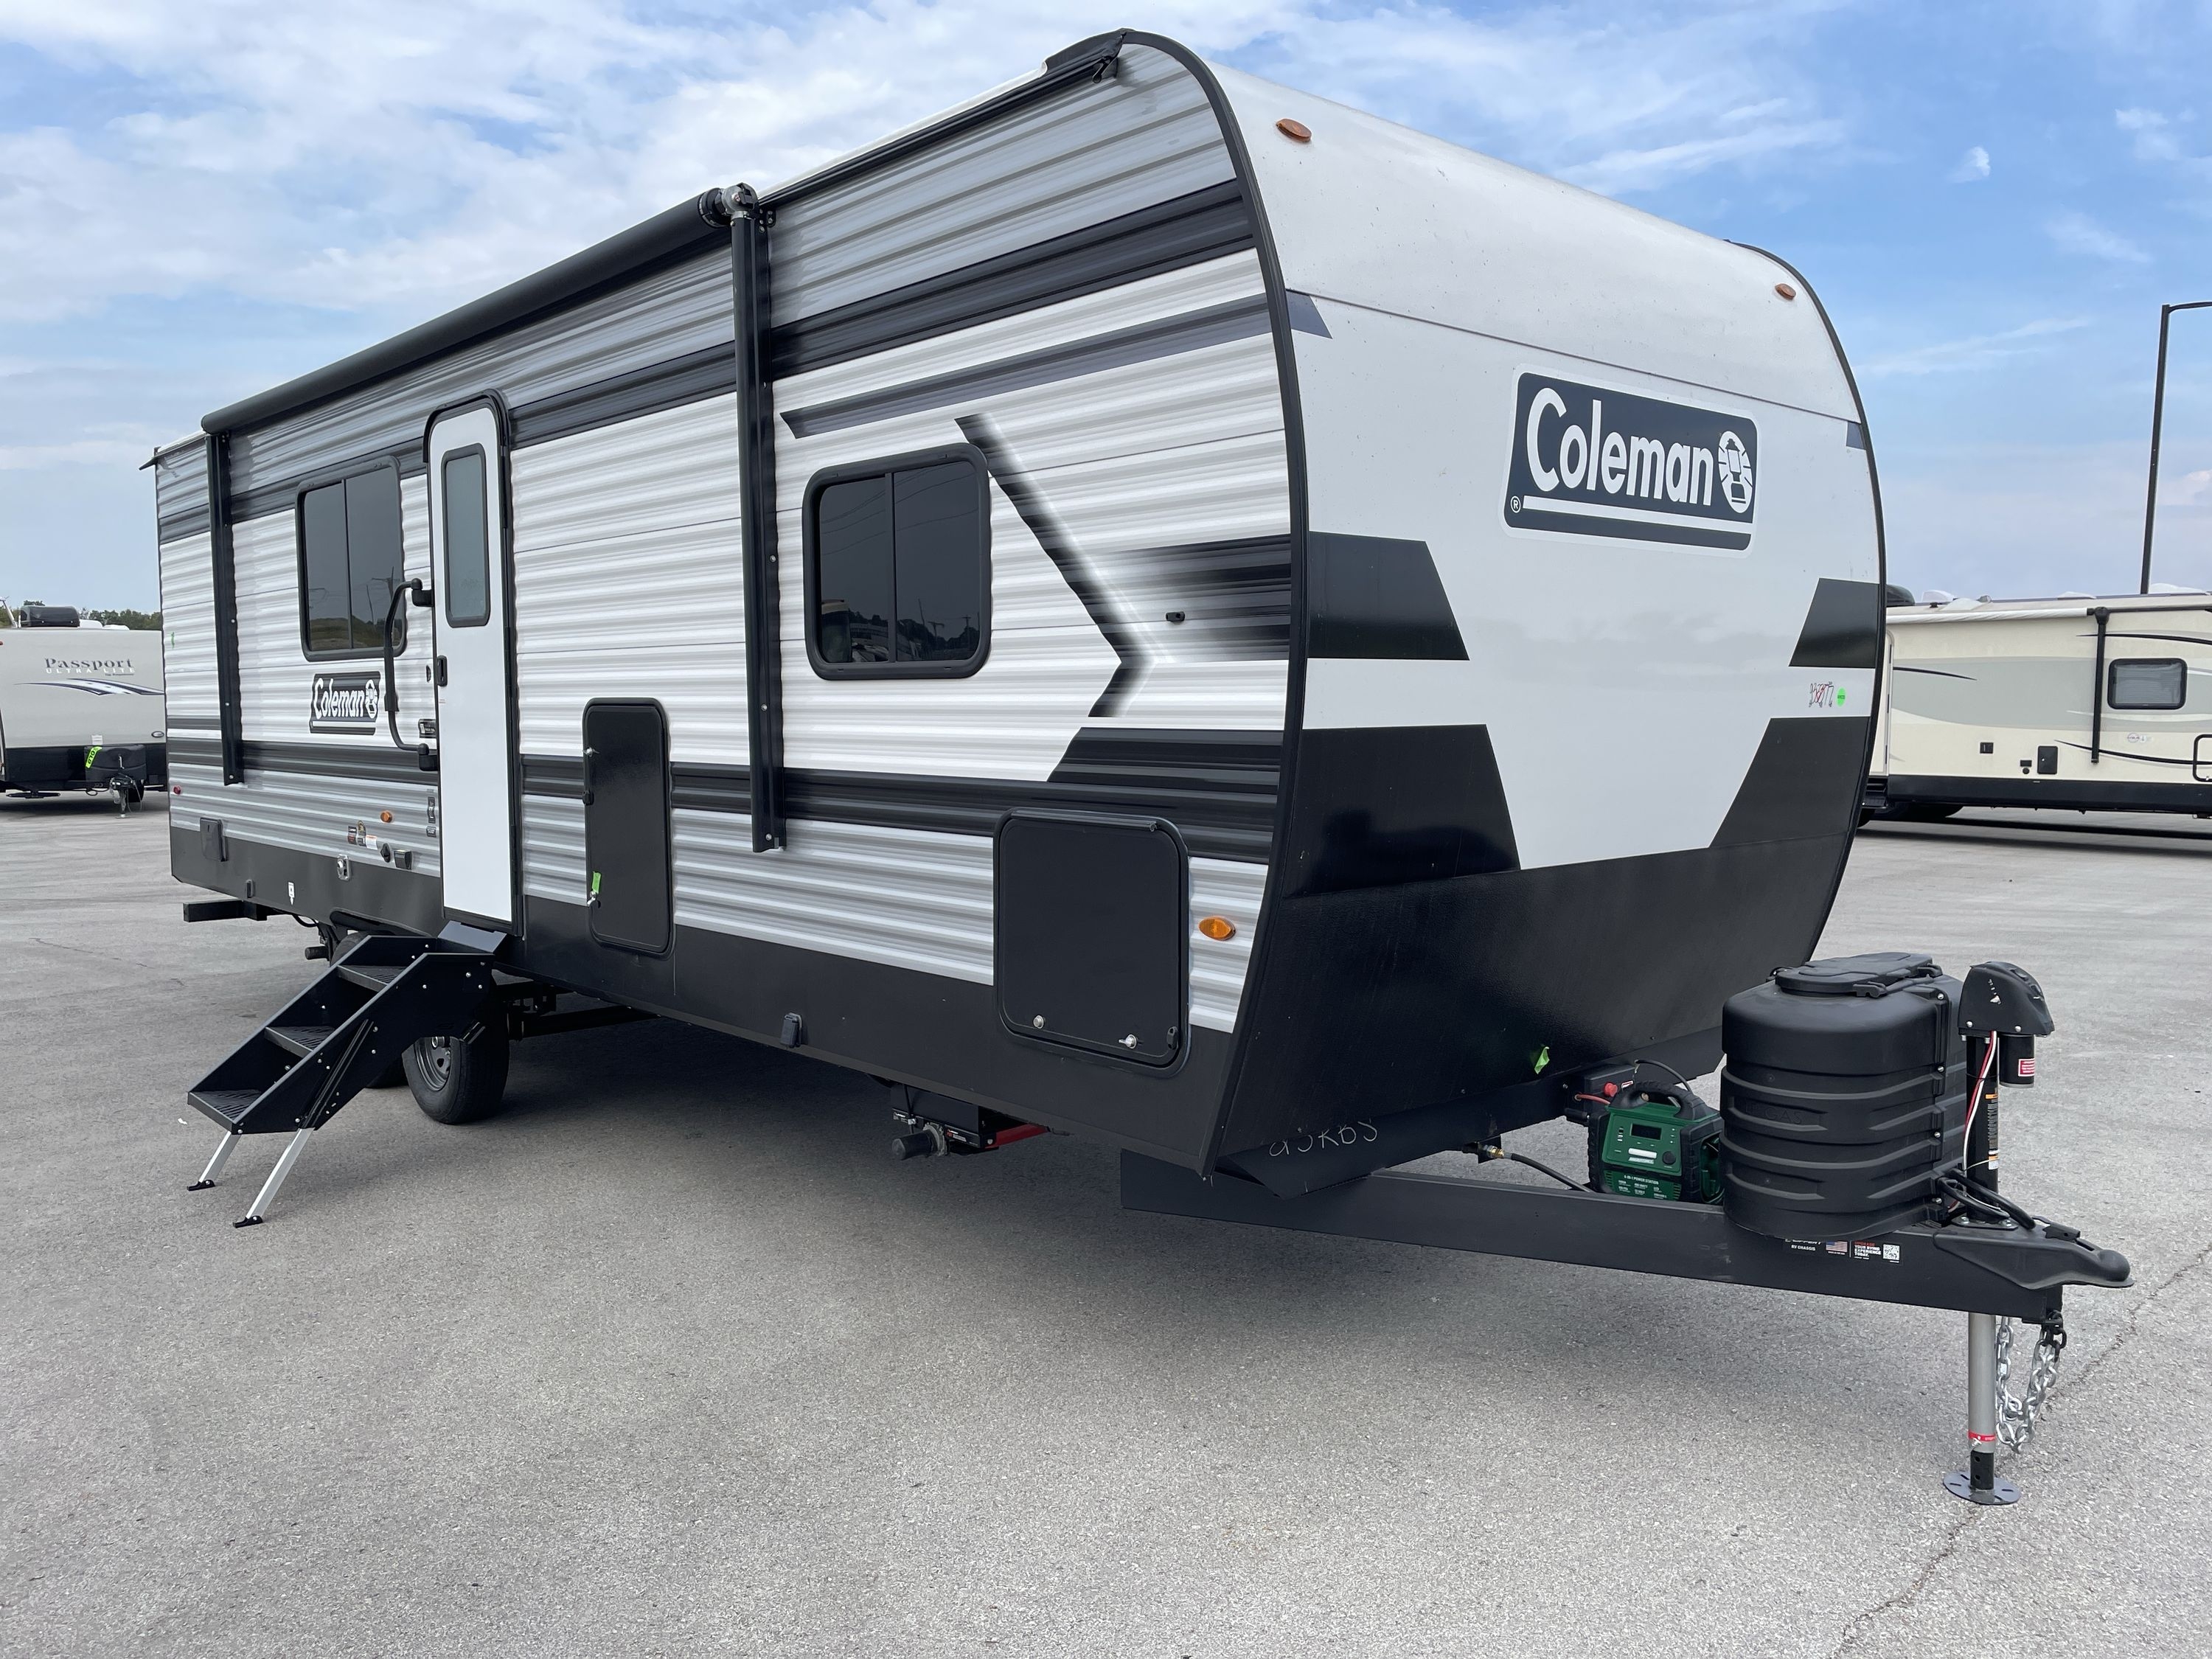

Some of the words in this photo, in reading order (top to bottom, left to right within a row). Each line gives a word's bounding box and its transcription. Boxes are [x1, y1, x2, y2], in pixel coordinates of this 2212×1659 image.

[1526, 387, 1714, 507] Coleman
[45, 658, 133, 670] Passport
[313, 678, 365, 720] Coleman
